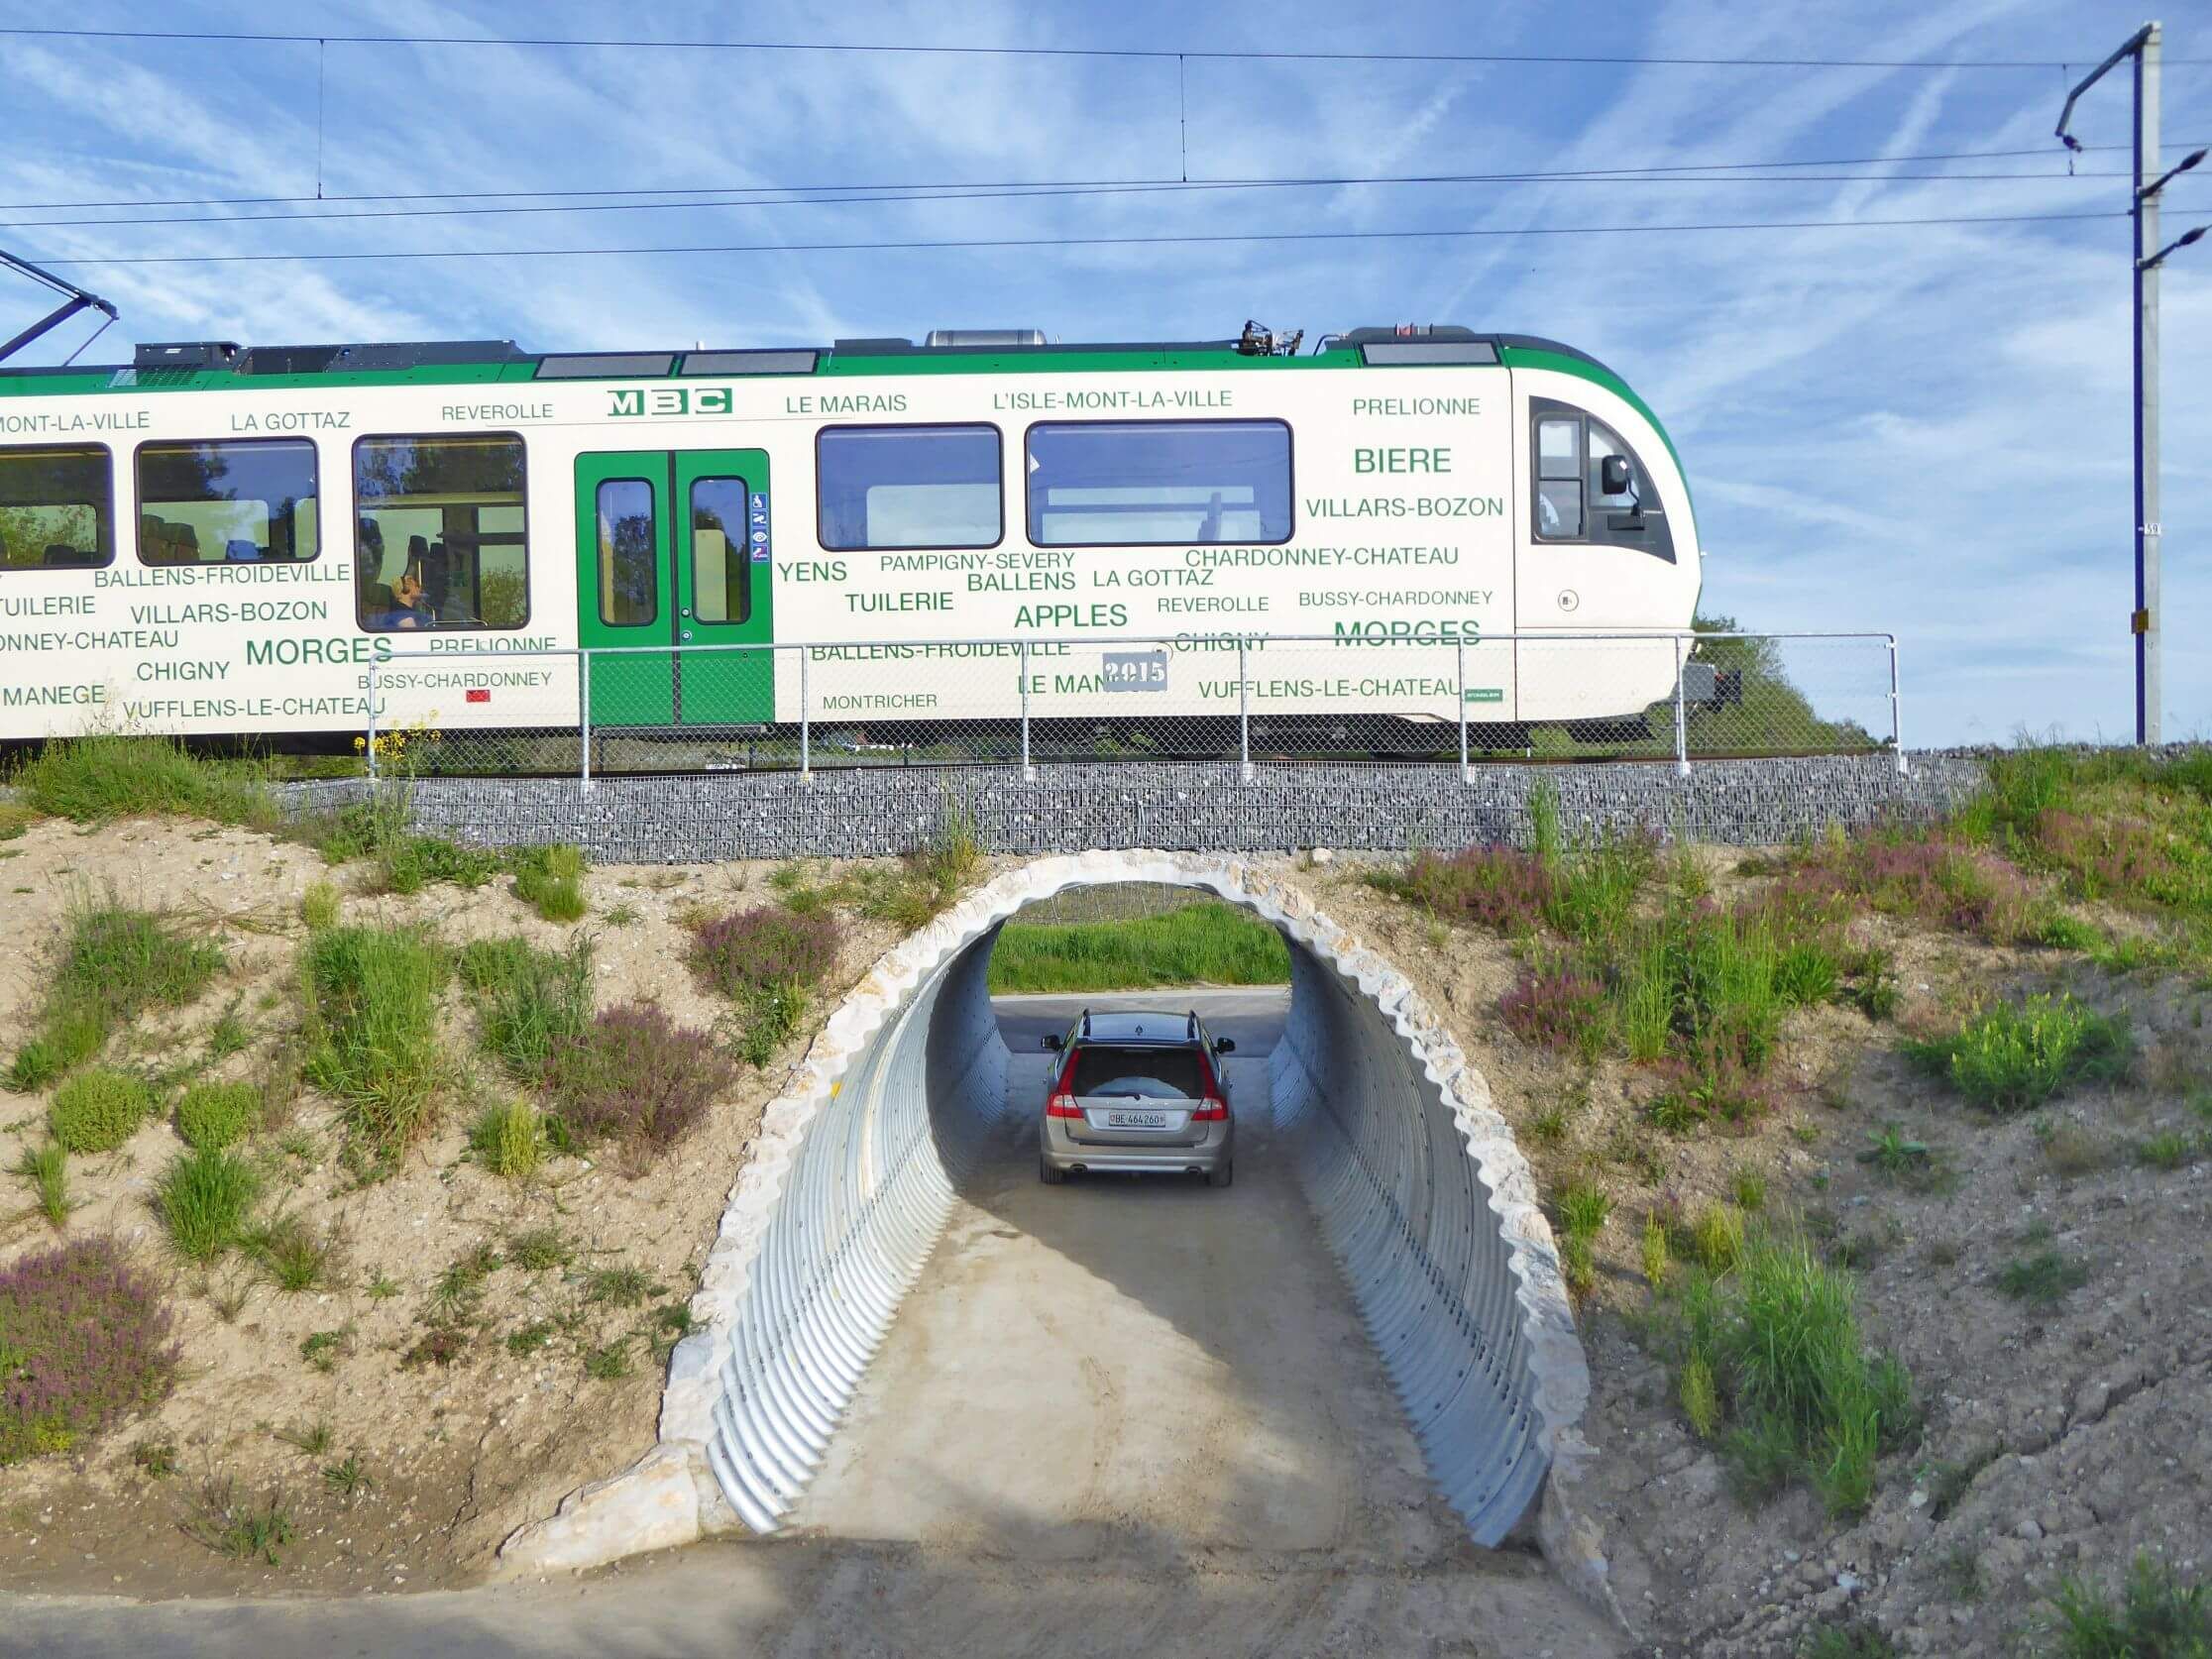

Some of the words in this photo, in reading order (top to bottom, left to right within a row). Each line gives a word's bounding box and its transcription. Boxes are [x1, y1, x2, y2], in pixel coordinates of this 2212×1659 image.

[607, 387, 733, 416] MBC
[787, 396, 813, 414] LE
[821, 394, 908, 412] MARAIS
[994, 389, 1233, 410] L'ISLE-MONT-LA-VILLE
[1353, 398, 1481, 415] PRELIONNE
[0, 411, 151, 433] ONT-LA-VILLE
[231, 414, 258, 431] LA
[266, 411, 351, 429] GOTTAZ
[442, 404, 553, 421] REVEROLLE
[1355, 448, 1452, 474] BIERE
[1305, 498, 1504, 517] VILLARS-BOZON
[880, 552, 1075, 572] PAMPIGNY-SEVERY
[1184, 547, 1459, 567] CHARDONNEY-CHATEAU
[95, 564, 350, 588] BALLENS-FROIDEVILLE
[777, 561, 847, 582] YENS
[1093, 571, 1121, 587] LA
[1128, 569, 1214, 587] GOTTAZ
[967, 572, 1076, 592] BALLENS
[0, 596, 96, 615] UILERIE
[845, 592, 954, 612] TUILERIE
[1158, 597, 1270, 612] REVEROLLE
[1298, 591, 1493, 607] BUSSY-CHARDONNEY
[131, 602, 327, 624] VILLARS-BOZON
[1014, 605, 1128, 628] APPLES
[1174, 632, 1270, 651] CHIGNY
[1335, 621, 1481, 646] MORGES
[247, 637, 392, 665] MORGES
[137, 661, 230, 681] CHIGNY
[358, 672, 552, 690] BUSSY-CHARDONNEY
[1104, 661, 1165, 683] 2015
[1018, 676, 1047, 694] LE
[1198, 678, 1461, 699] VUFFLENS-LE-CHATEAU
[3, 686, 105, 707] MANEGE
[823, 694, 938, 710] MONTRICHER
[123, 697, 386, 719] VUFFLENS-LE-CHATEAU
